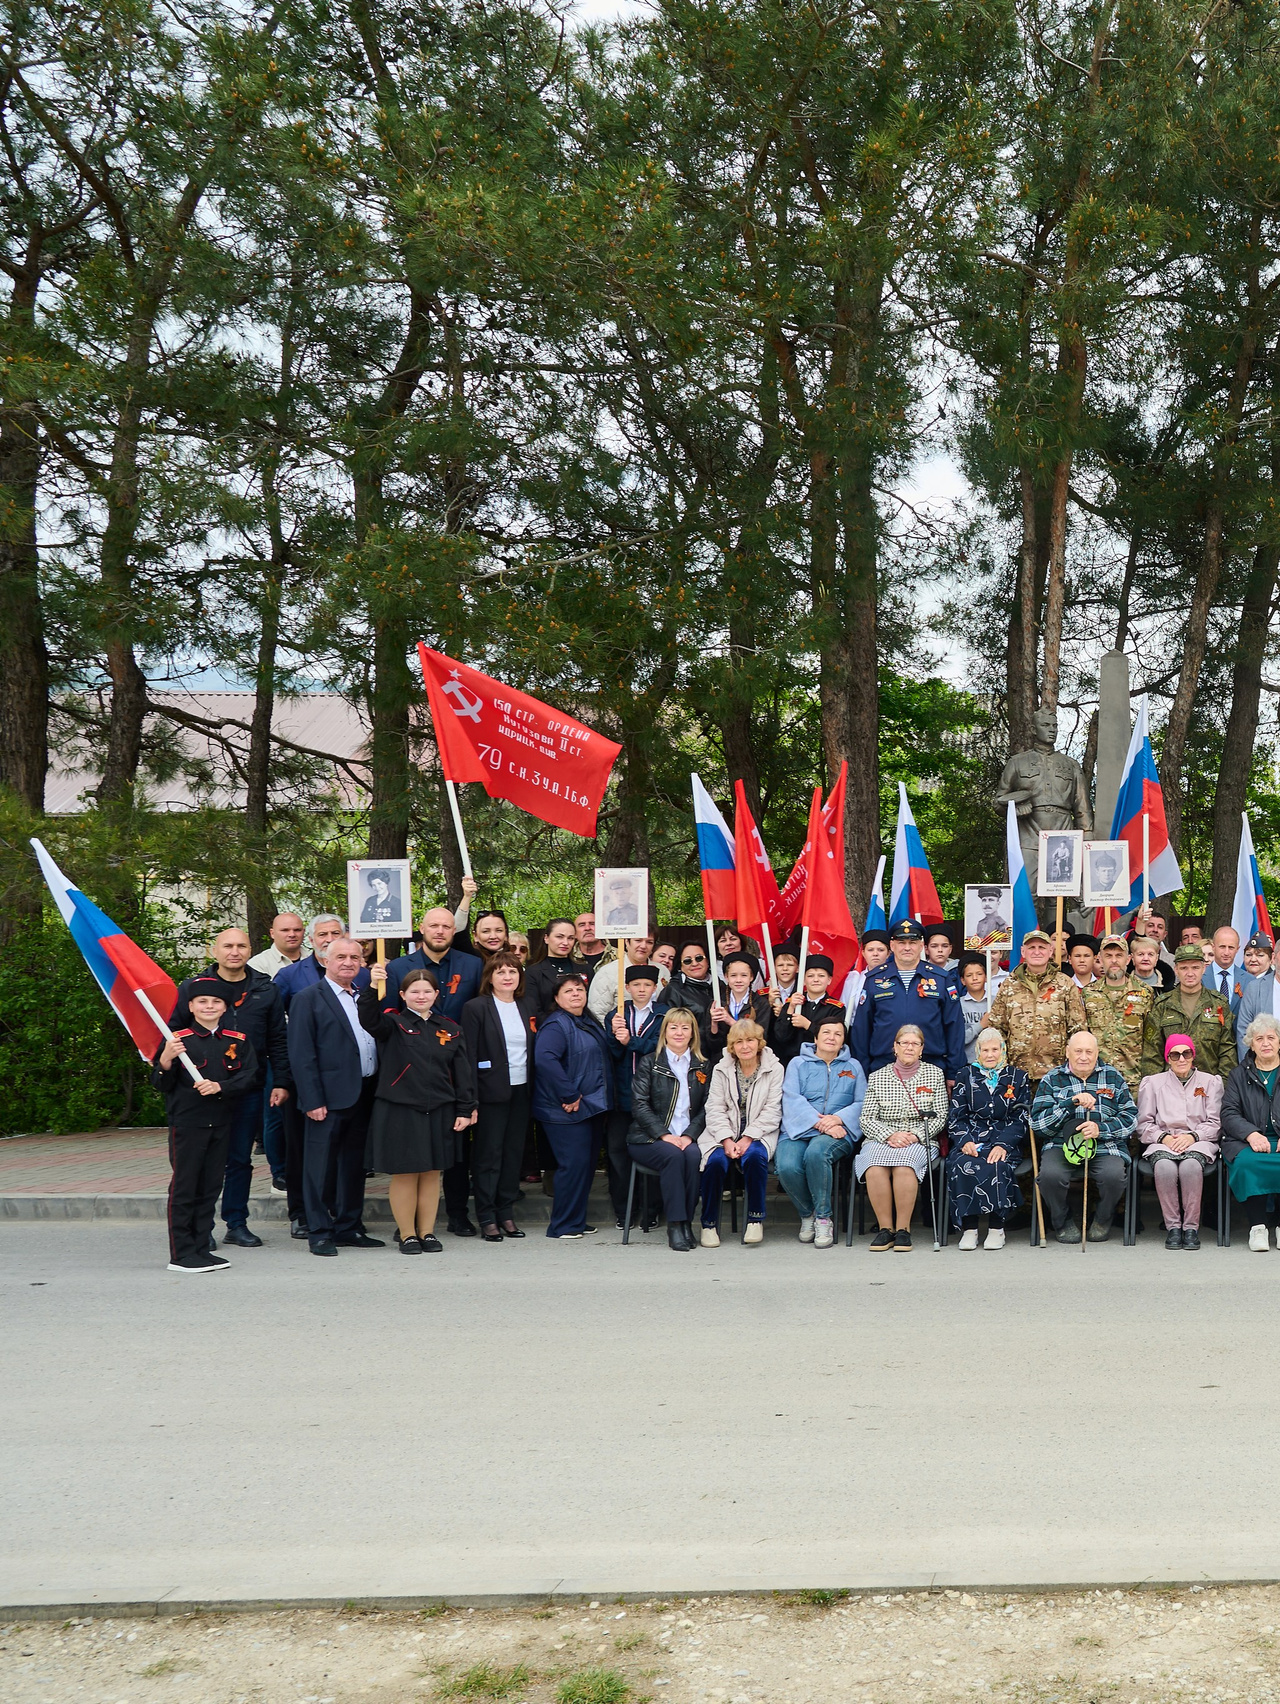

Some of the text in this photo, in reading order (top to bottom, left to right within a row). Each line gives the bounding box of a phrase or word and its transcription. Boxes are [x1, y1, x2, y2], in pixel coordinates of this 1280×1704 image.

[493, 698, 591, 741] 150 СТР. ОРДЕНА
[477, 743, 502, 770] 79
[569, 746, 584, 759] СТ.
